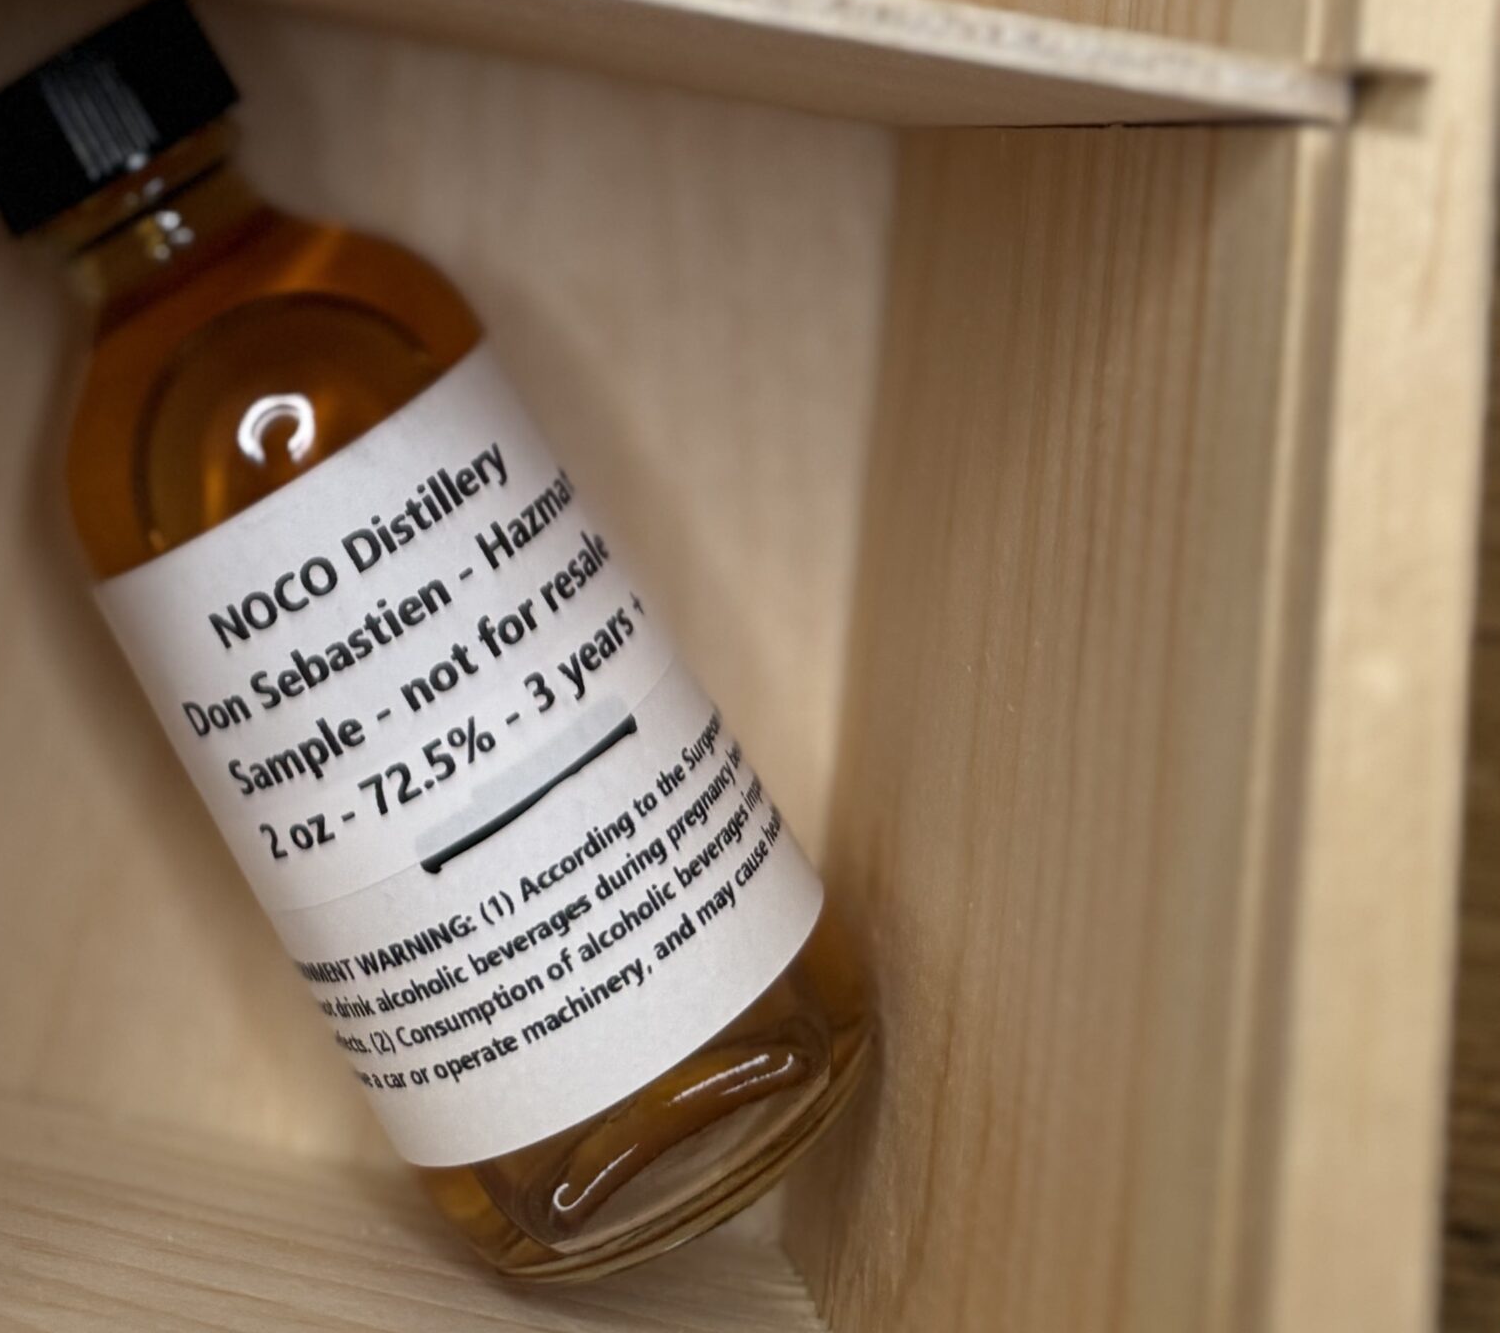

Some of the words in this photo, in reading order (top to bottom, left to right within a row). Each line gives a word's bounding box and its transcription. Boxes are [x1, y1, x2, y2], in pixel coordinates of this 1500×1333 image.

[183, 696, 252, 737] Don
[250, 580, 452, 710] Sebastien
[209, 557, 338, 649] NOCO
[342, 443, 507, 574] Distillery
[229, 718, 365, 796] Sample
[401, 644, 479, 712] not
[478, 599, 537, 658] for
[540, 532, 608, 613] resale
[260, 824, 288, 860] 2
[290, 814, 335, 850] oz
[358, 717, 496, 816] 72.5%
[524, 673, 555, 713] 3
[558, 609, 633, 701] years
[336, 995, 376, 1018] drink
[376, 966, 469, 1012] alcoholic
[468, 895, 592, 976] beverages
[595, 838, 668, 900] during
[666, 762, 735, 851] pregnancy
[355, 915, 477, 976] WARNING:
[480, 891, 514, 925] (1)
[520, 812, 636, 902] According
[633, 793, 657, 818] to
[656, 765, 685, 797] the
[370, 1030, 396, 1055] (2)
[396, 975, 544, 1047] Consumption
[547, 947, 573, 981] of
[578, 882, 676, 962] alcoholic
[673, 804, 748, 888] beverages
[383, 1073, 407, 1088] car
[410, 1068, 429, 1085] or
[433, 1036, 518, 1083] operate
[522, 958, 652, 1044] machinery,
[654, 913, 696, 960] and
[696, 881, 735, 926] may
[735, 840, 768, 887] cause
